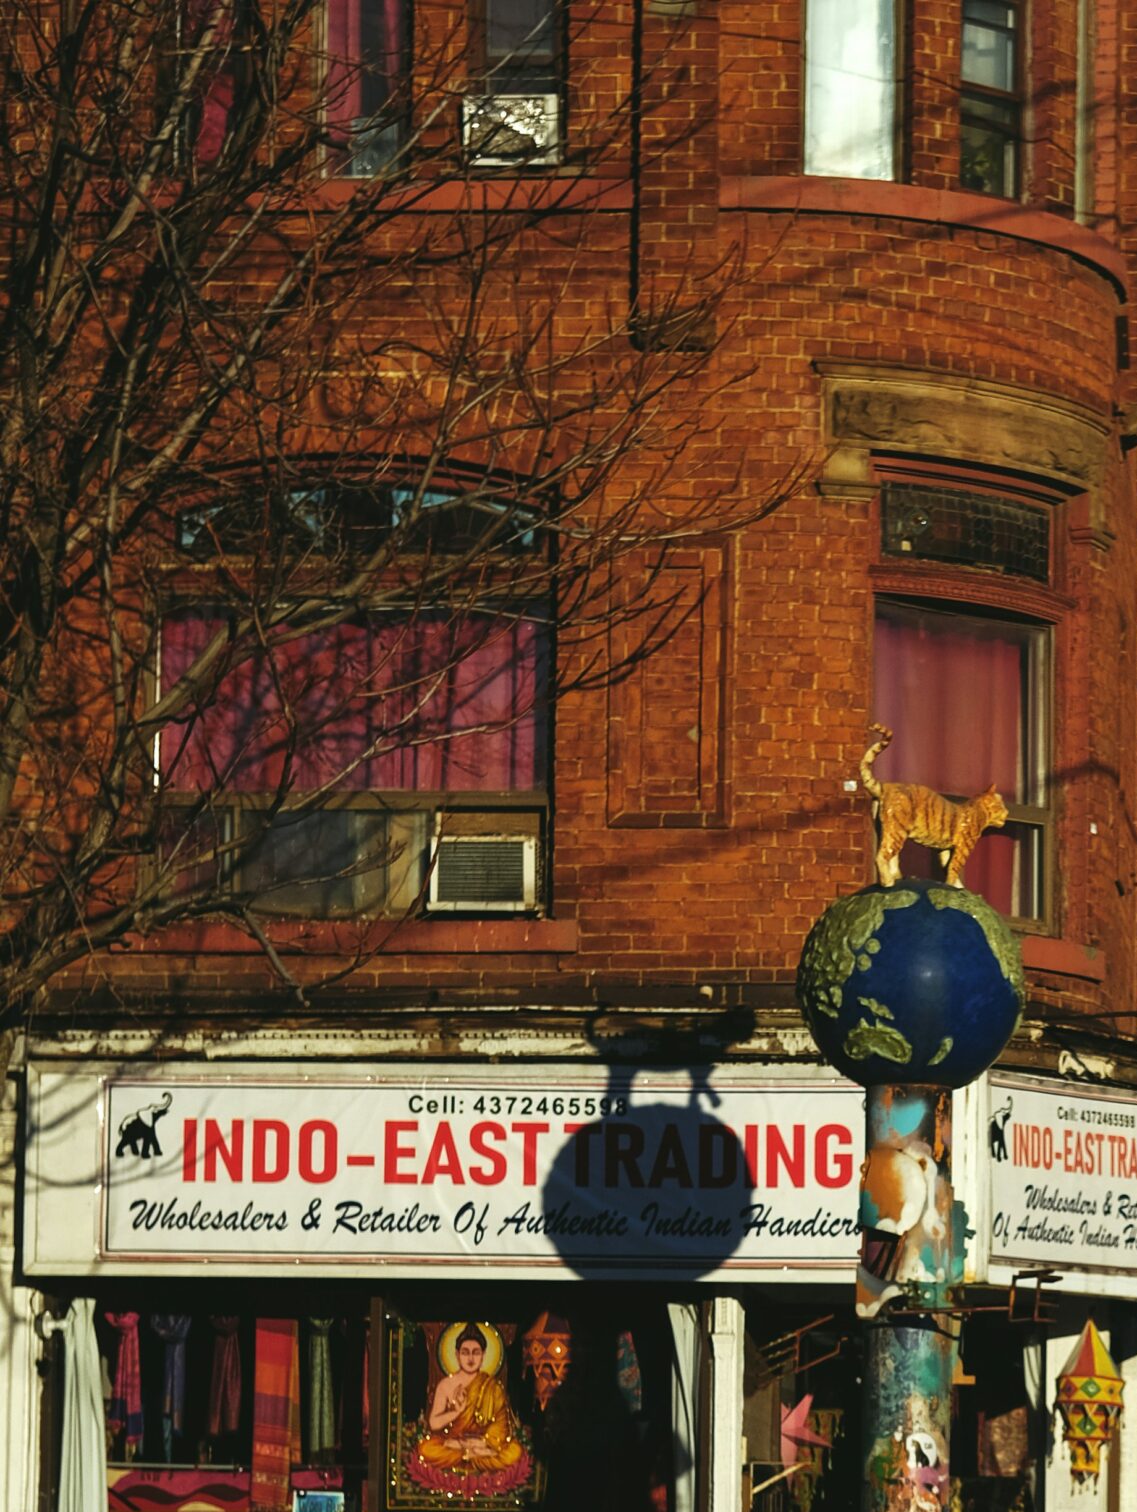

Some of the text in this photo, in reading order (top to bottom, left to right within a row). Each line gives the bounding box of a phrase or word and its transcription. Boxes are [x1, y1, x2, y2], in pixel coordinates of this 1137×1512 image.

[408, 1095, 628, 1116] Cell: 4372465598
[182, 1118, 853, 1189] INDO-EAST TRADING
[1013, 1122, 1105, 1176] INDO-EAST
[129, 1196, 289, 1233] Wholesalers
[301, 1198, 321, 1231] &
[332, 1200, 441, 1234] Retailer
[453, 1200, 490, 1245] Of
[497, 1201, 629, 1237] Authentic
[640, 1202, 732, 1237] Indian
[1024, 1184, 1097, 1216] Wholesalers
[1103, 1191, 1112, 1216] &
[992, 1211, 1009, 1247] Of
[1013, 1215, 1074, 1246] Authentic
[1079, 1219, 1119, 1248] Indian
